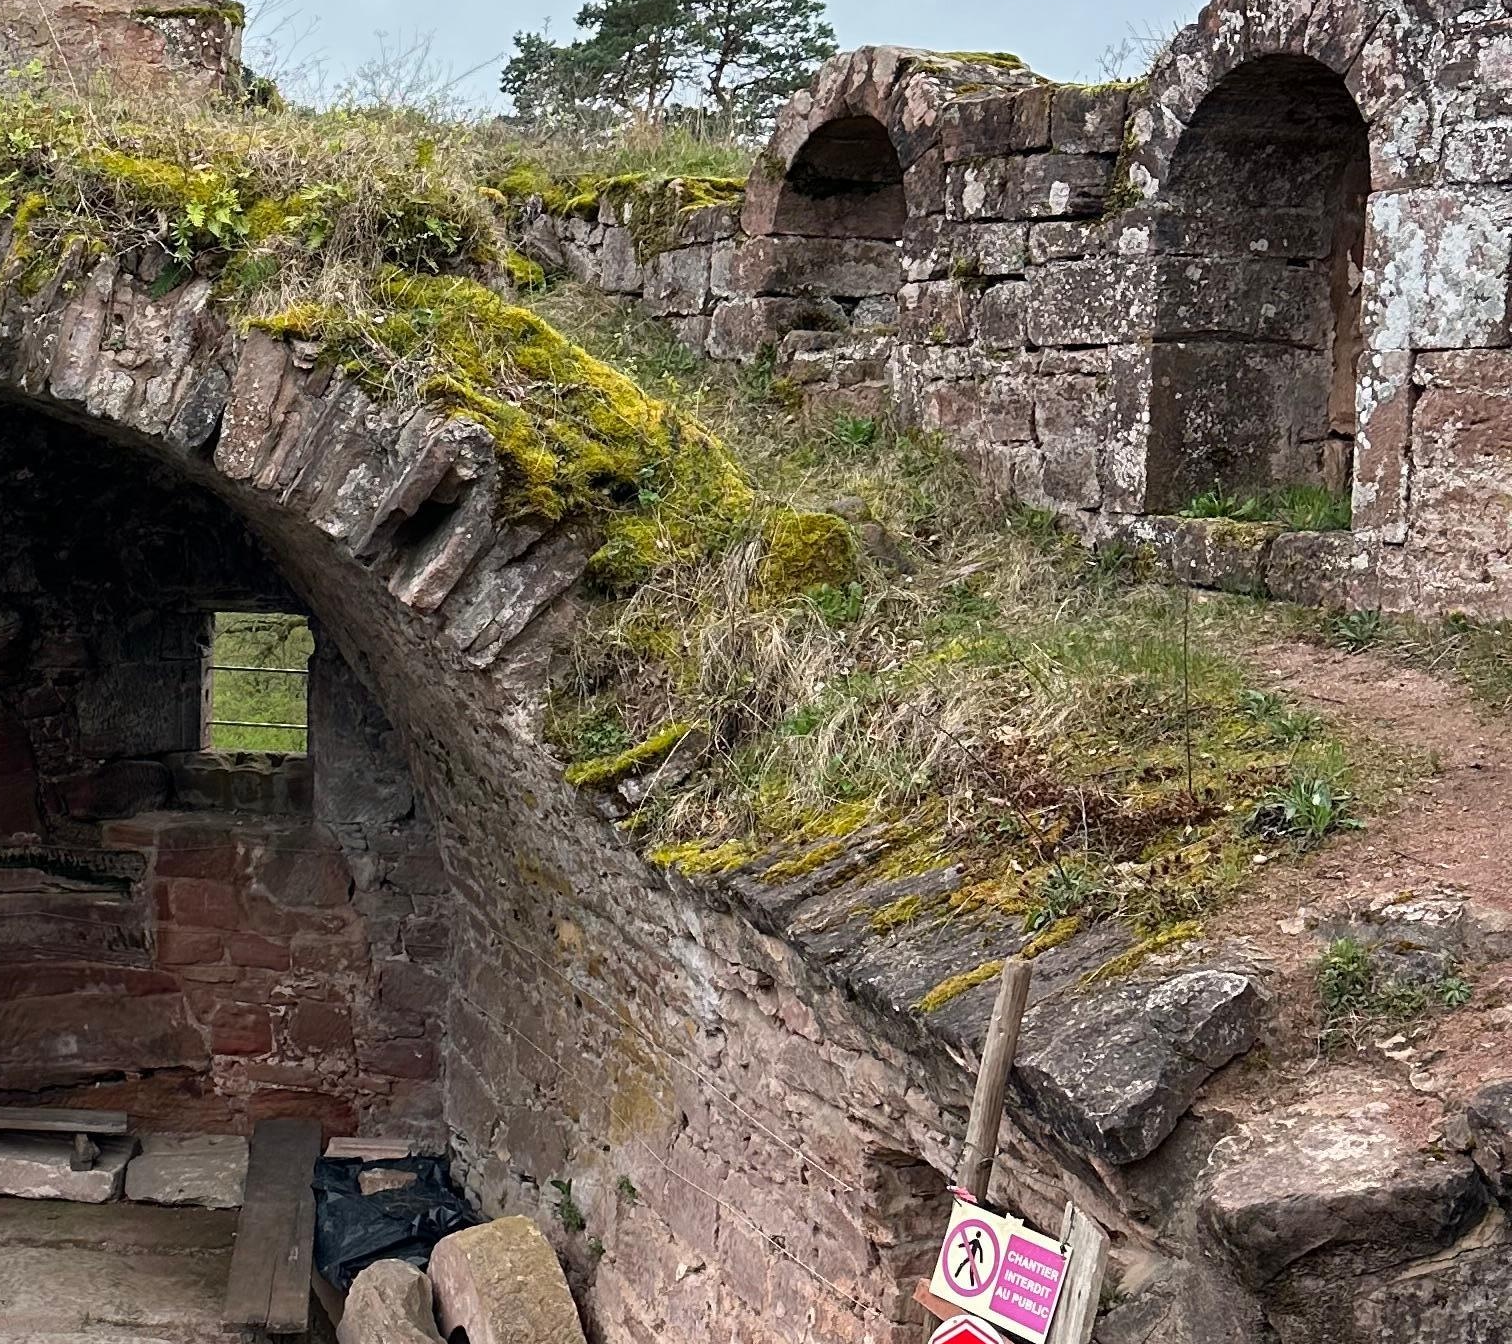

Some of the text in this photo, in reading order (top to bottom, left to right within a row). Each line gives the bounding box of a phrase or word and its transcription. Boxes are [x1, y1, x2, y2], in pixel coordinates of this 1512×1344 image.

[1007, 1250, 1059, 1282] CHANTIER
[1004, 1270, 1052, 1299] INTERDIT
[995, 1286, 1050, 1319] AU PUBLIC
